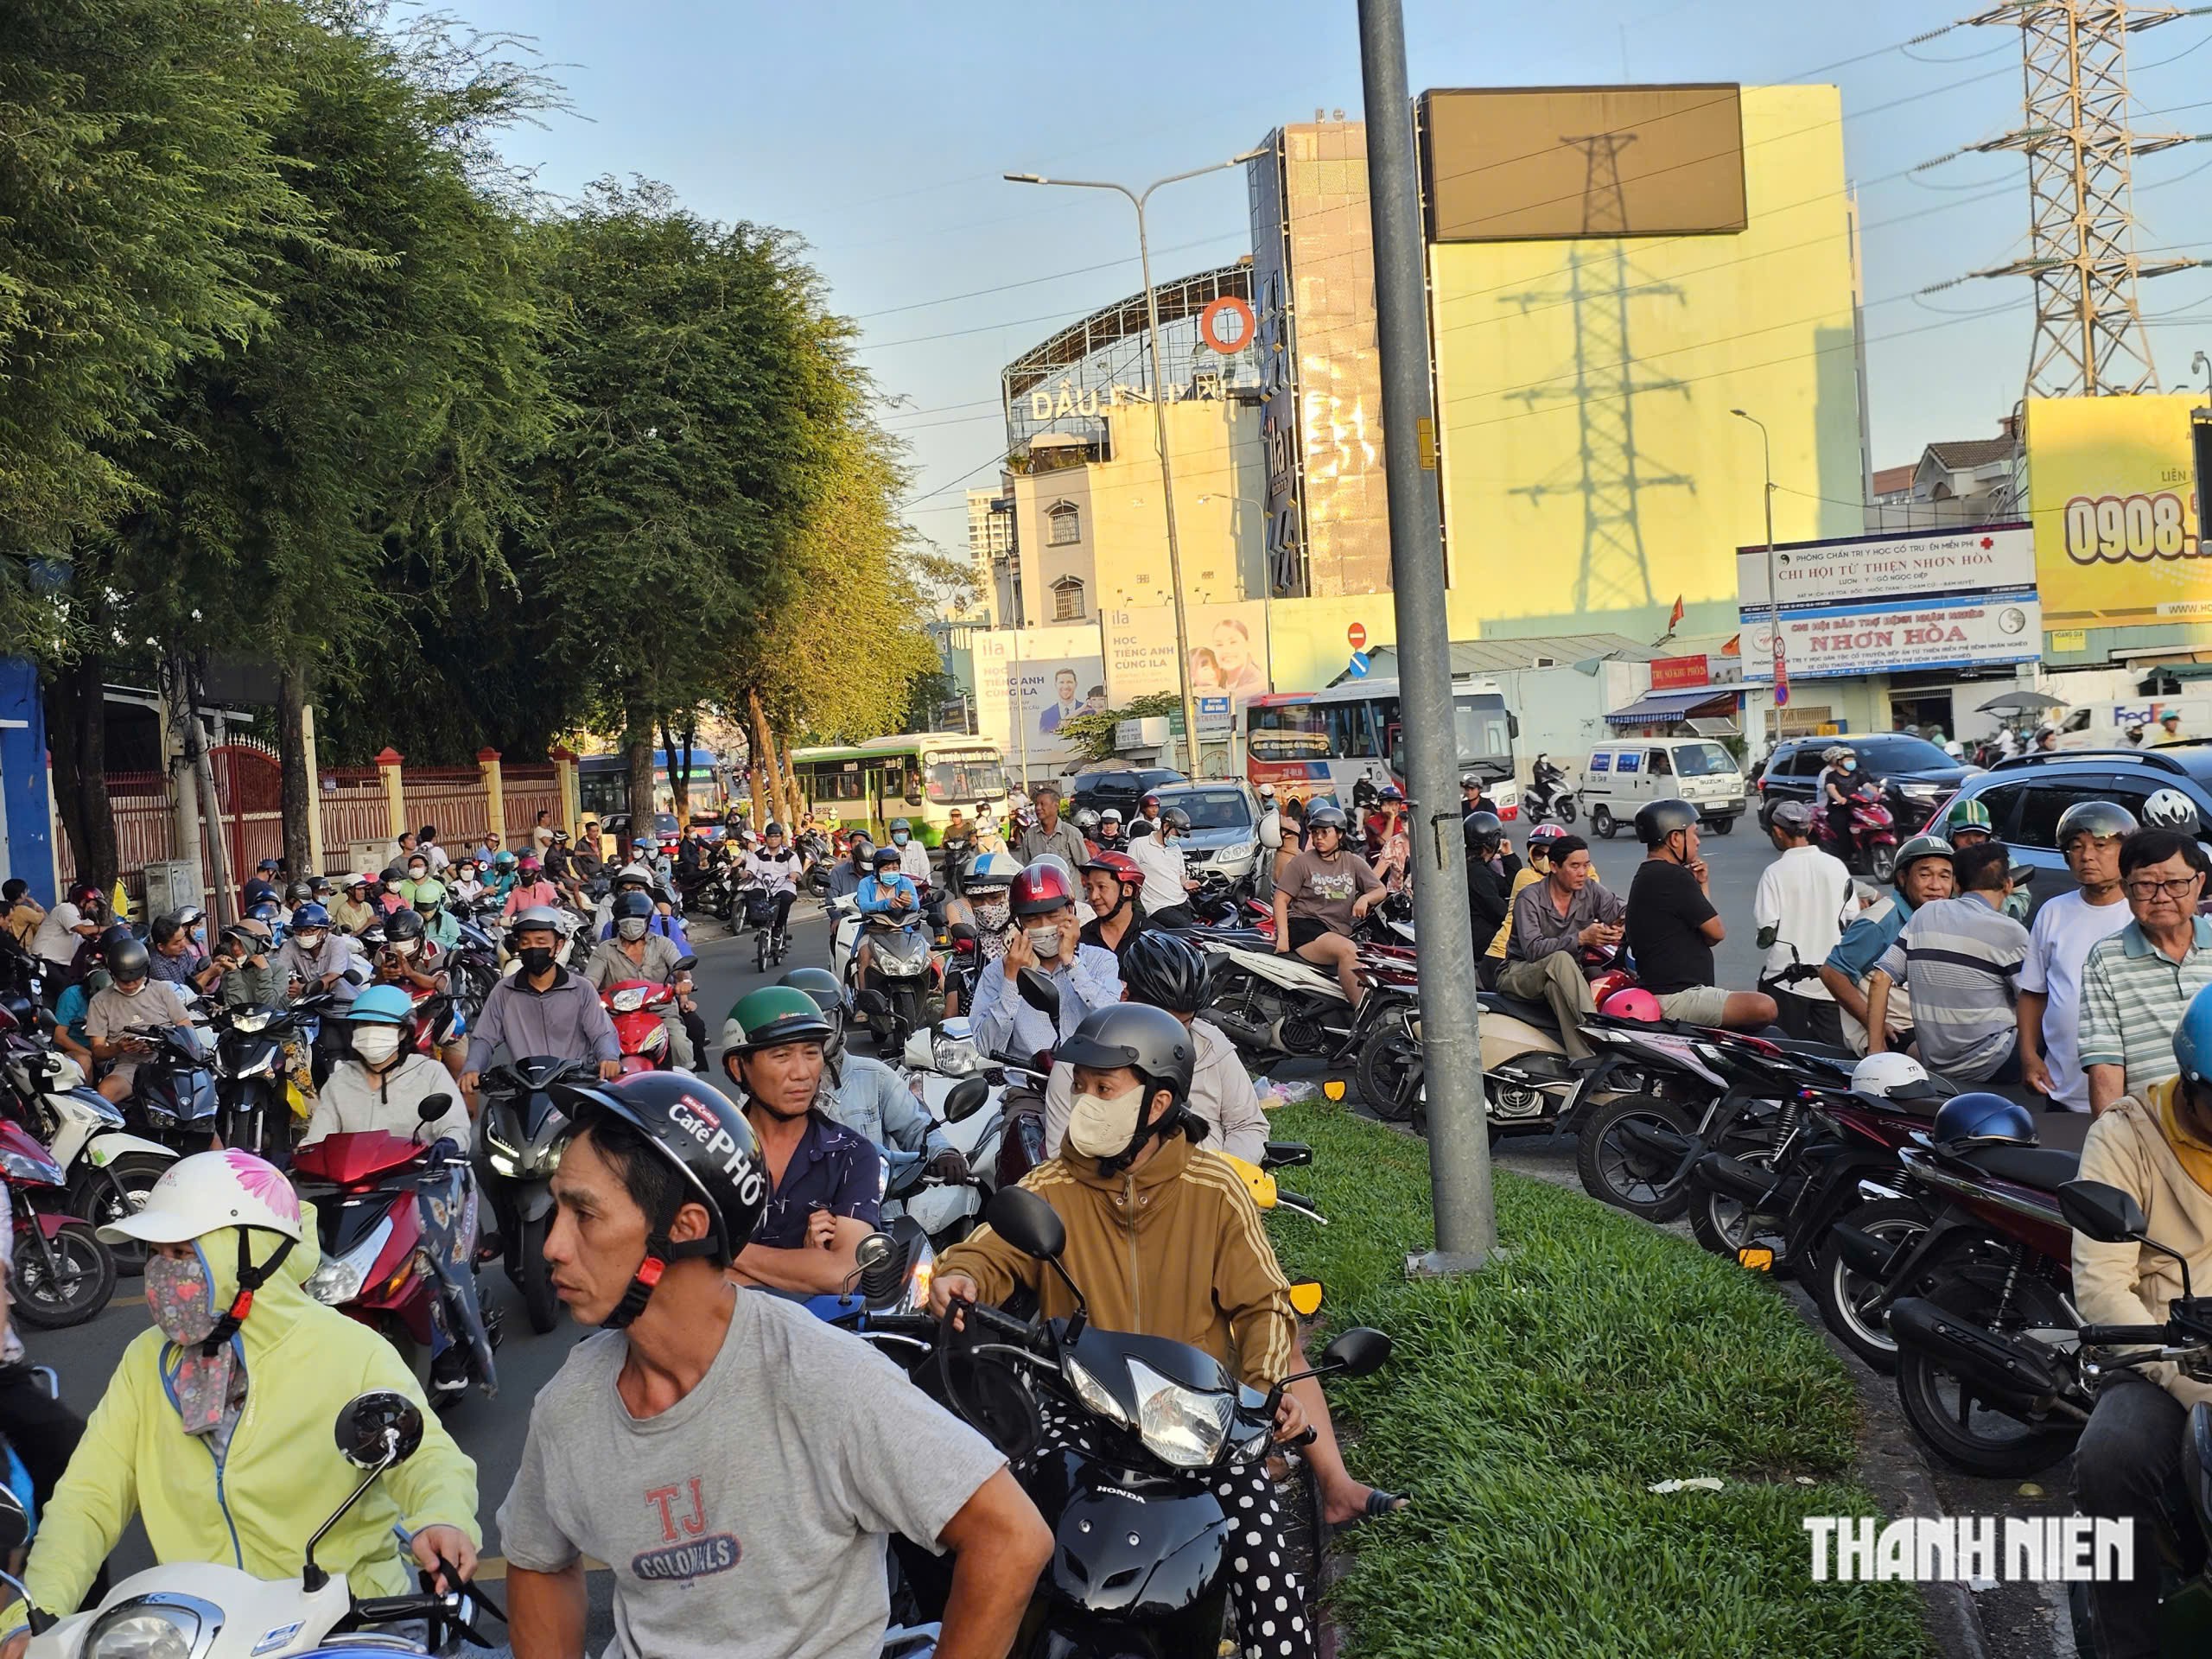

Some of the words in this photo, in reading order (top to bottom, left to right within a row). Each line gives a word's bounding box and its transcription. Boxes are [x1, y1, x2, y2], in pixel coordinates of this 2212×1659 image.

[1778, 570, 1803, 582] CHI
[1808, 566, 1834, 579] HỘI
[1913, 556, 1956, 569] NHƠN
[1962, 552, 1993, 564] HÒA
[1112, 609, 1129, 625] ila
[1809, 630, 1894, 652] NHƠN
[1904, 622, 1967, 645] HÒA
[1150, 645, 1175, 656] ANH
[1149, 658, 1167, 668] ILA
[1020, 676, 1045, 684] ANH
[668, 1103, 715, 1143] Café
[1096, 1484, 1147, 1504] HONDA
[645, 1476, 709, 1543] TJ
